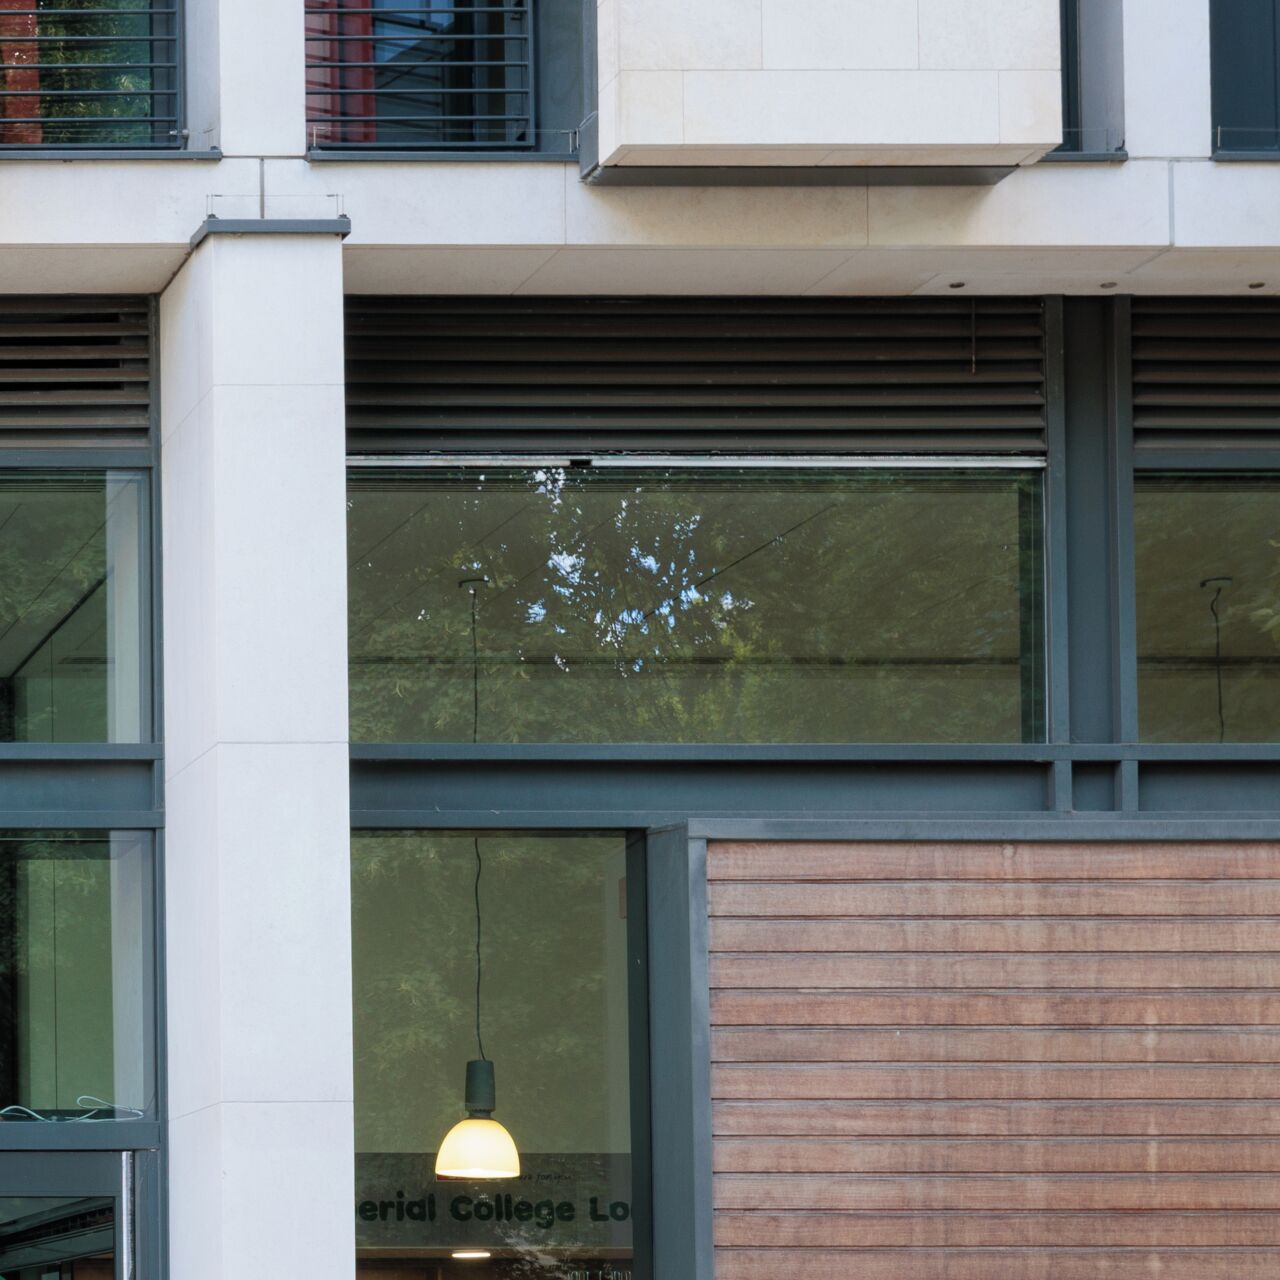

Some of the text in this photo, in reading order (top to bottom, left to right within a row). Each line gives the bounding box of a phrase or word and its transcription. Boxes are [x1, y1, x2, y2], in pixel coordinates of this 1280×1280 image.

[355, 1190, 632, 1229] erial College Lo
